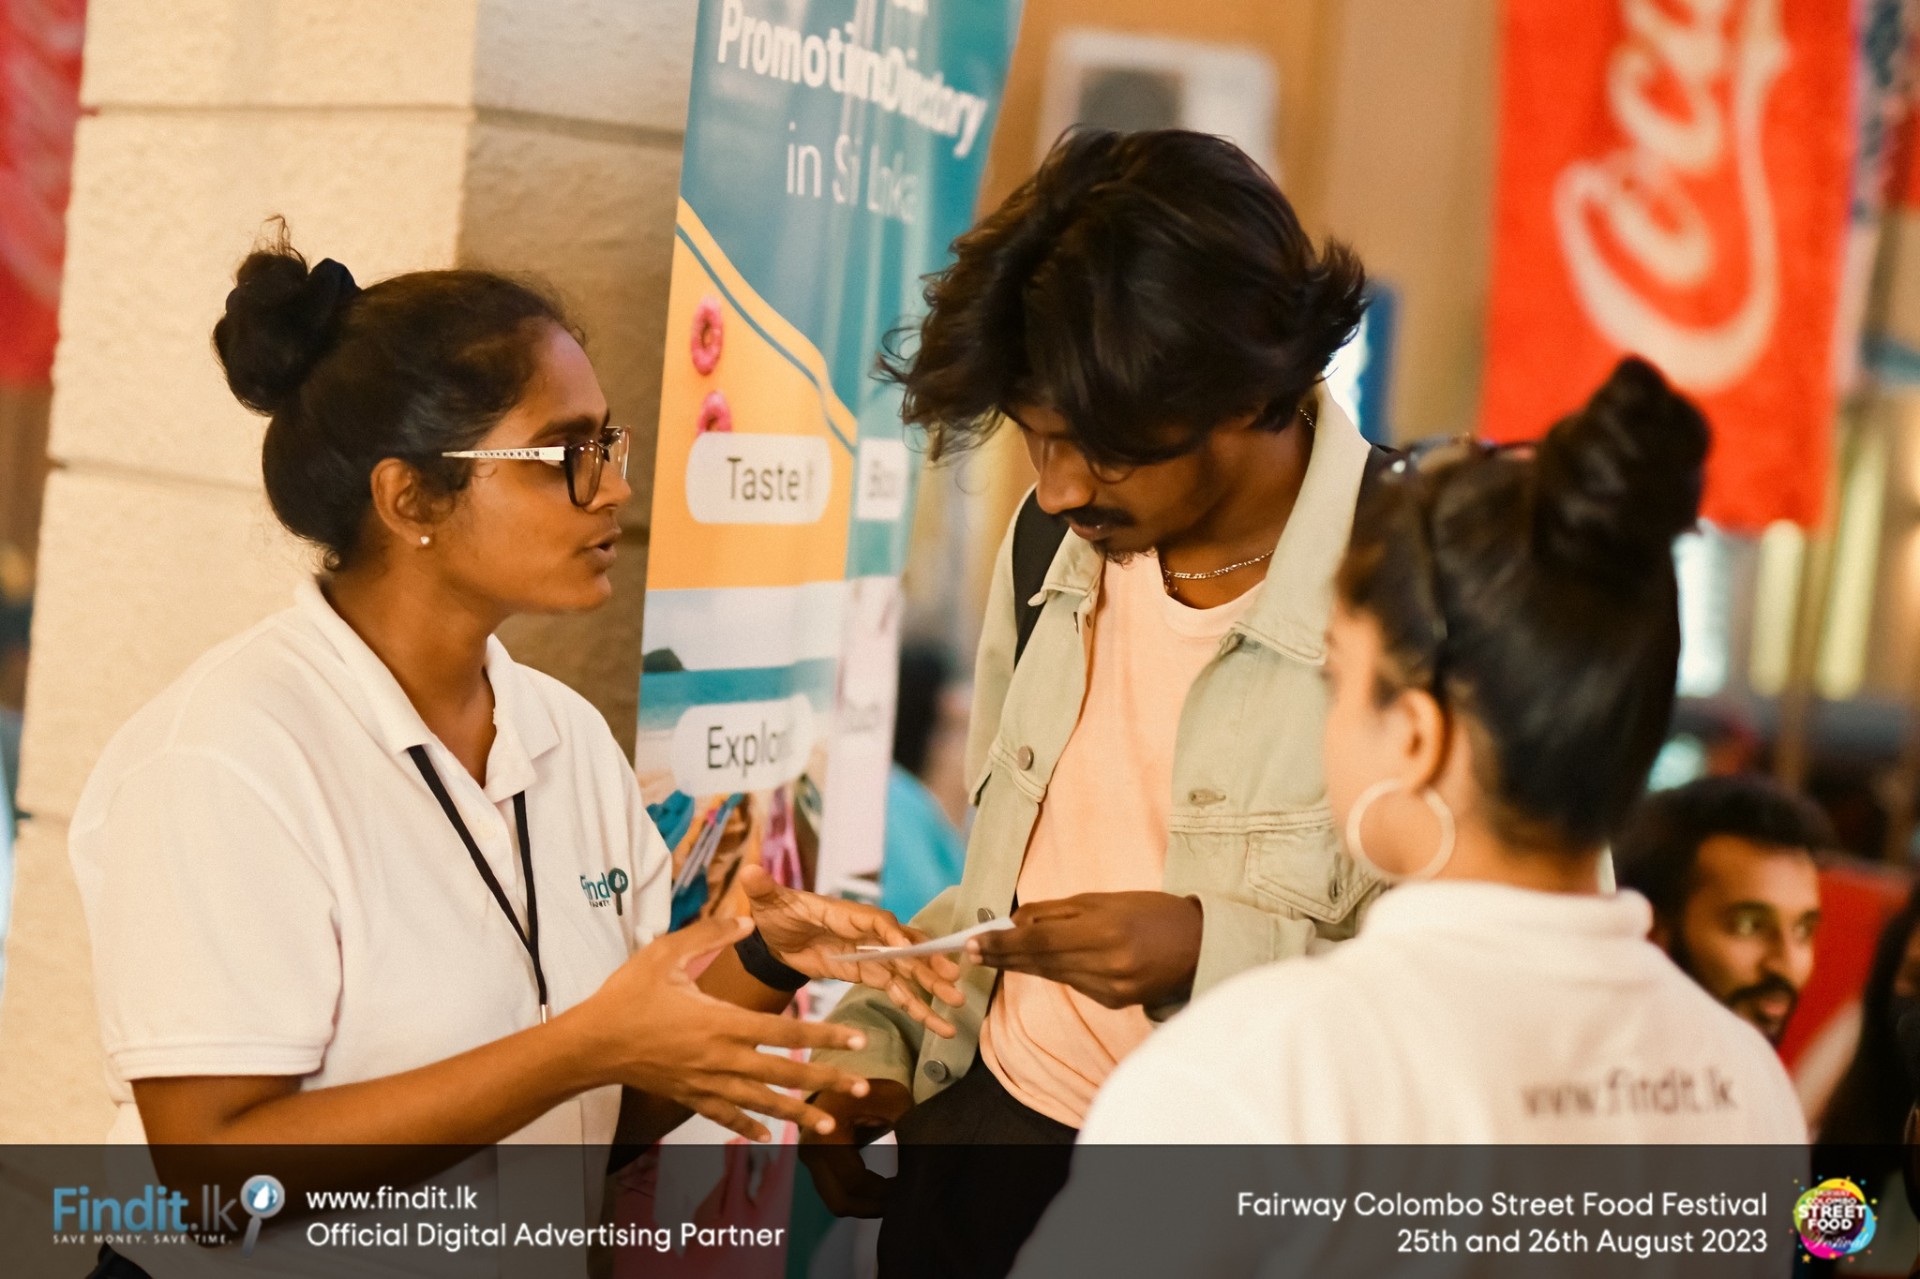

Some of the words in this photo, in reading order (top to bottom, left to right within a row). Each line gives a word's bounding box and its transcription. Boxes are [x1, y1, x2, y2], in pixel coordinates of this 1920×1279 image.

[786, 120, 822, 199] in
[832, 134, 864, 207] Si
[726, 456, 802, 502] Taste
